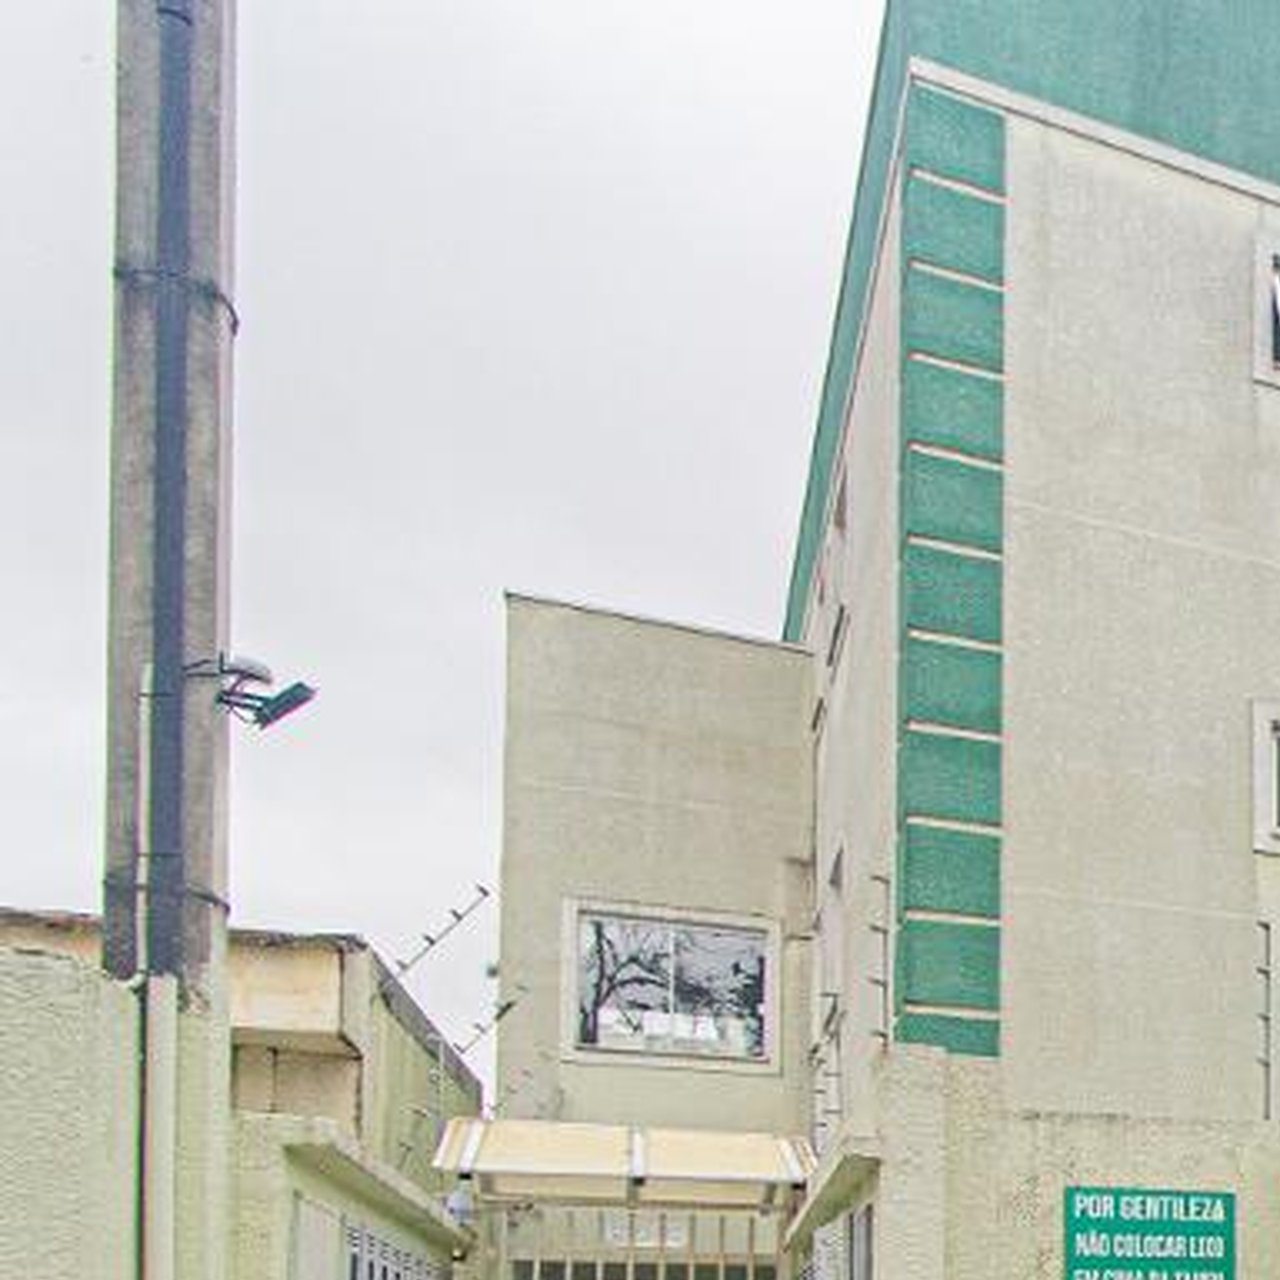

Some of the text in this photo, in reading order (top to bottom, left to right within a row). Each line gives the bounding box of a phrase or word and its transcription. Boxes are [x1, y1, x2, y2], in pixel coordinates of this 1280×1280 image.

[1074, 1194, 1226, 1221] POR GENTILEZA
[1075, 1230, 1111, 1257] NÃO
[1113, 1234, 1187, 1258] COLOCAR
